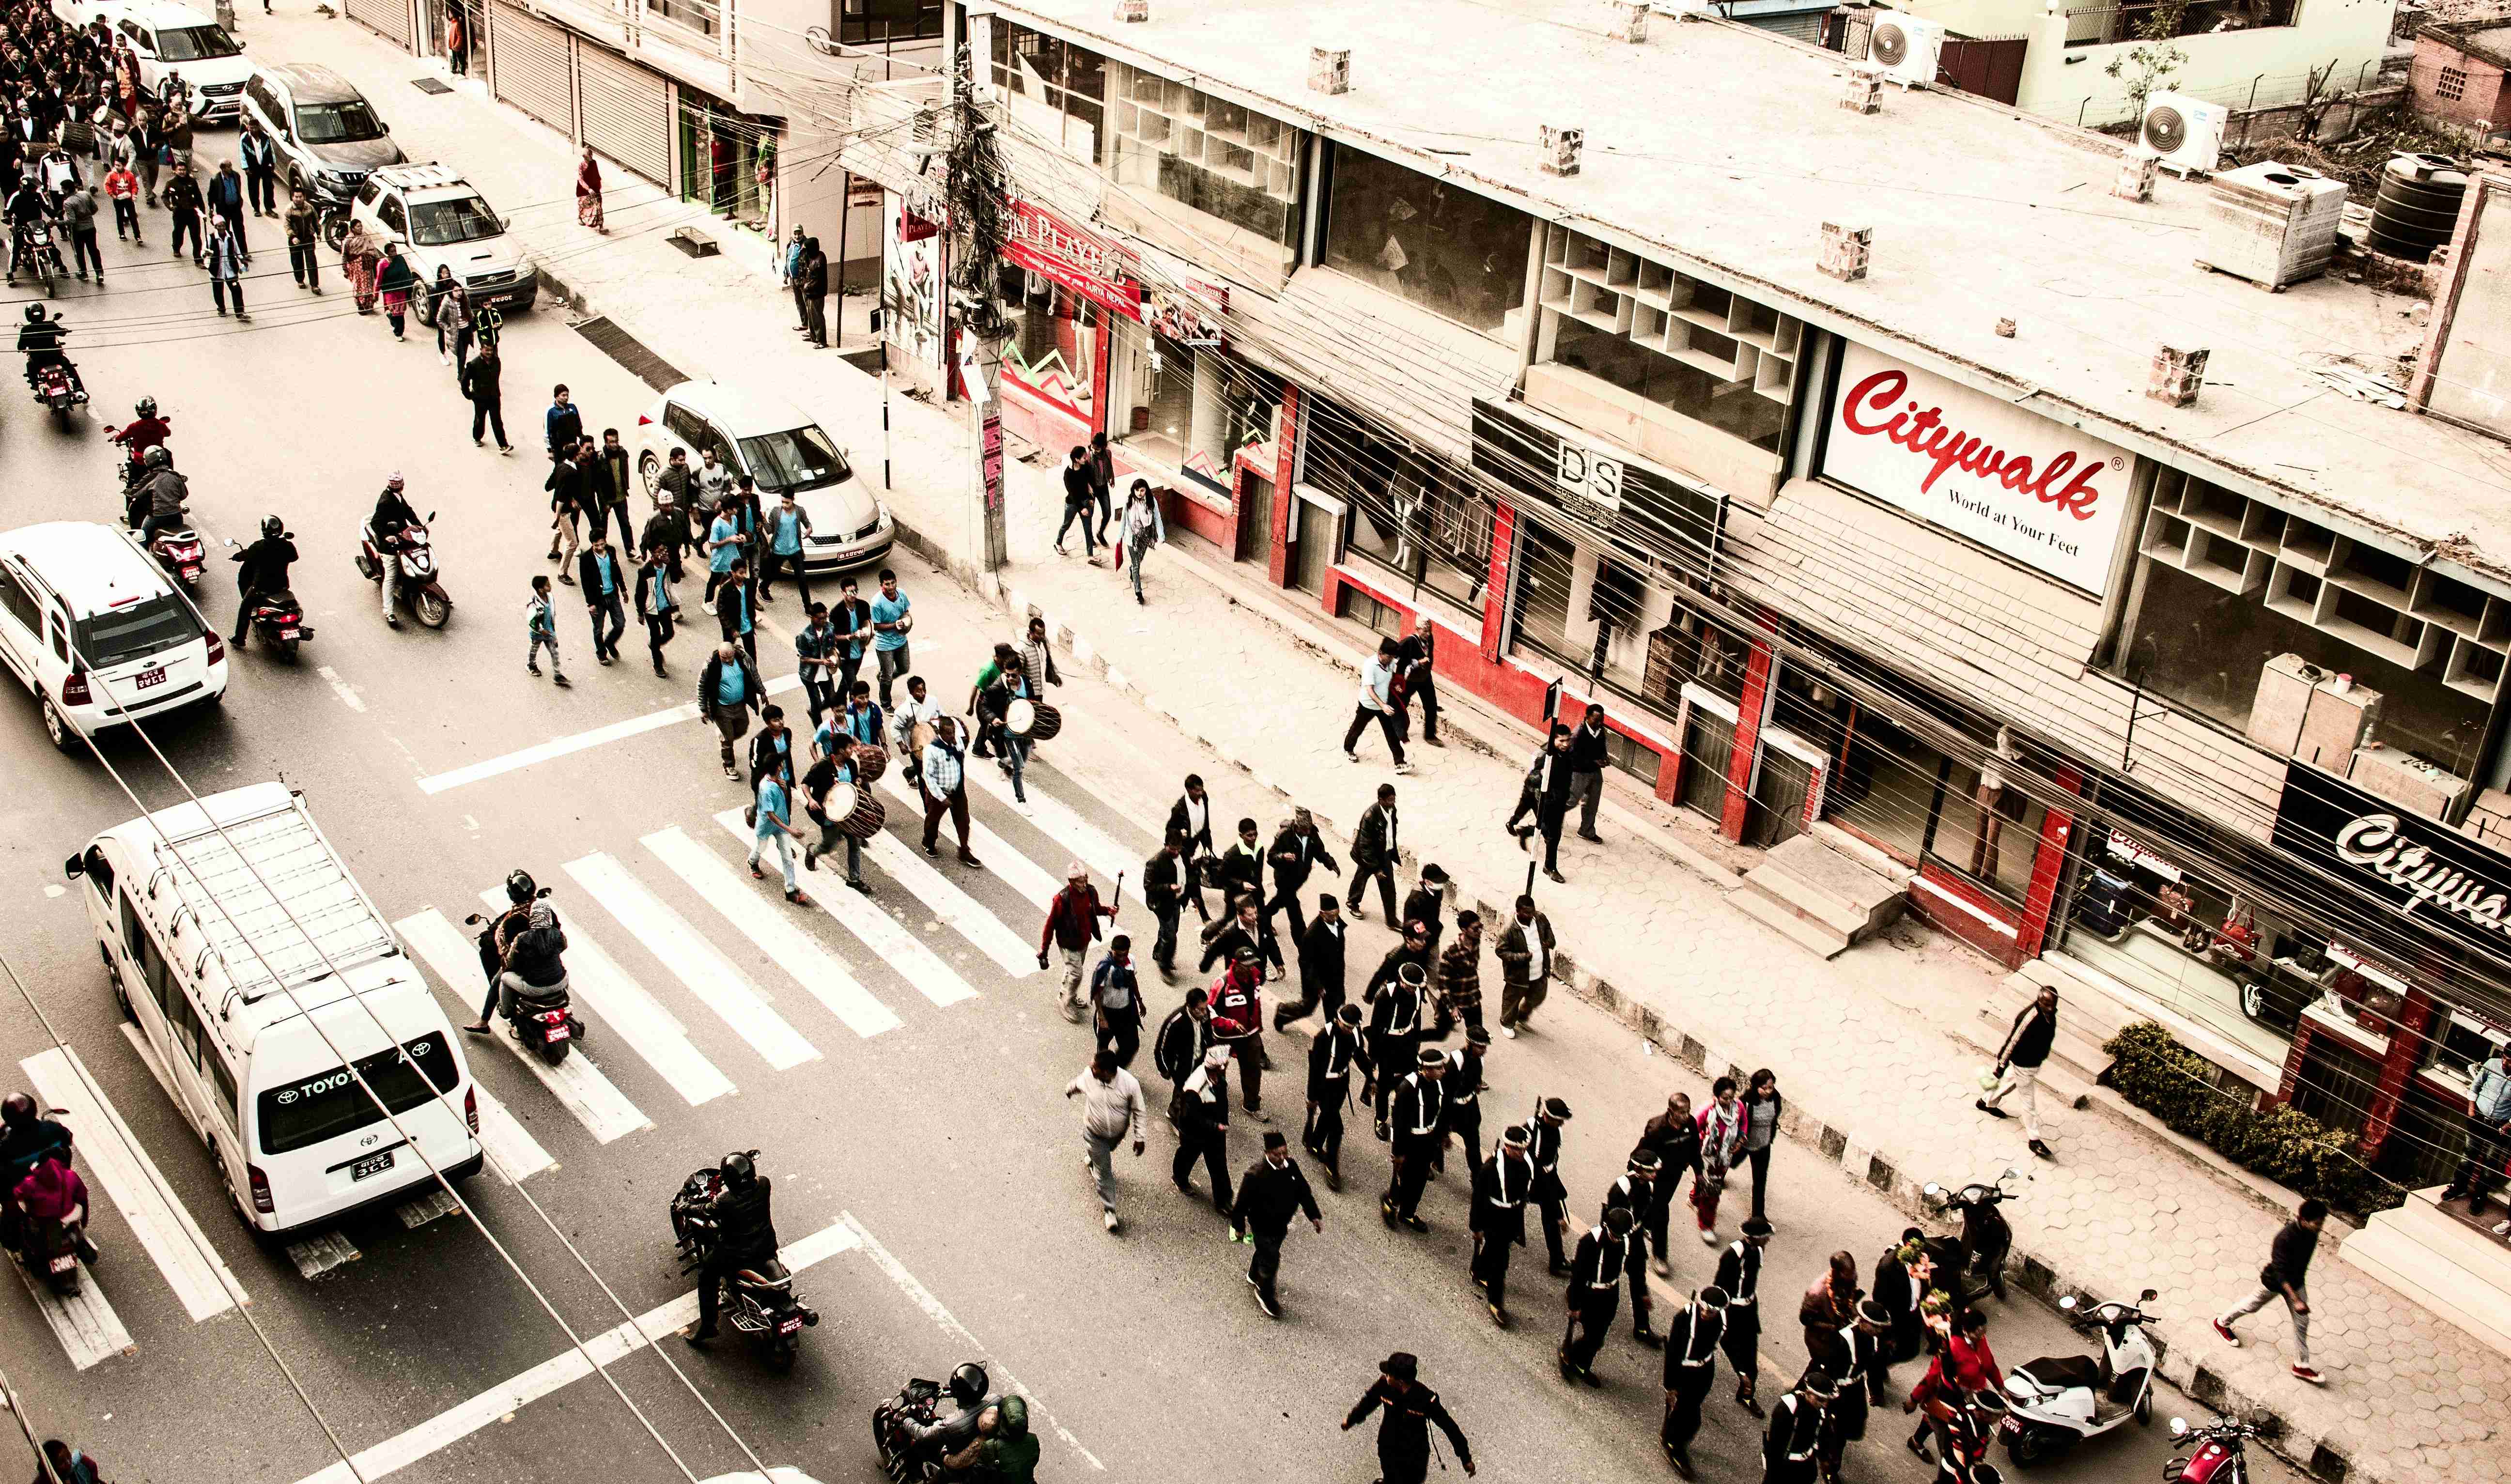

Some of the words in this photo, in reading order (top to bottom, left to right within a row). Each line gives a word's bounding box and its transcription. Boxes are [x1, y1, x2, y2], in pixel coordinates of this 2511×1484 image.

[1085, 281, 1105, 298] SURYA
[1106, 290, 1126, 308] NEPAL
[1843, 370, 2105, 521] Citywalk
[1562, 503, 1590, 522] Manbhawan,
[1591, 517, 1608, 529] Lalitpur
[1948, 489, 1989, 518] World
[1993, 511, 2008, 526] at
[2012, 515, 2046, 540] Your
[2048, 533, 2079, 557] Feet
